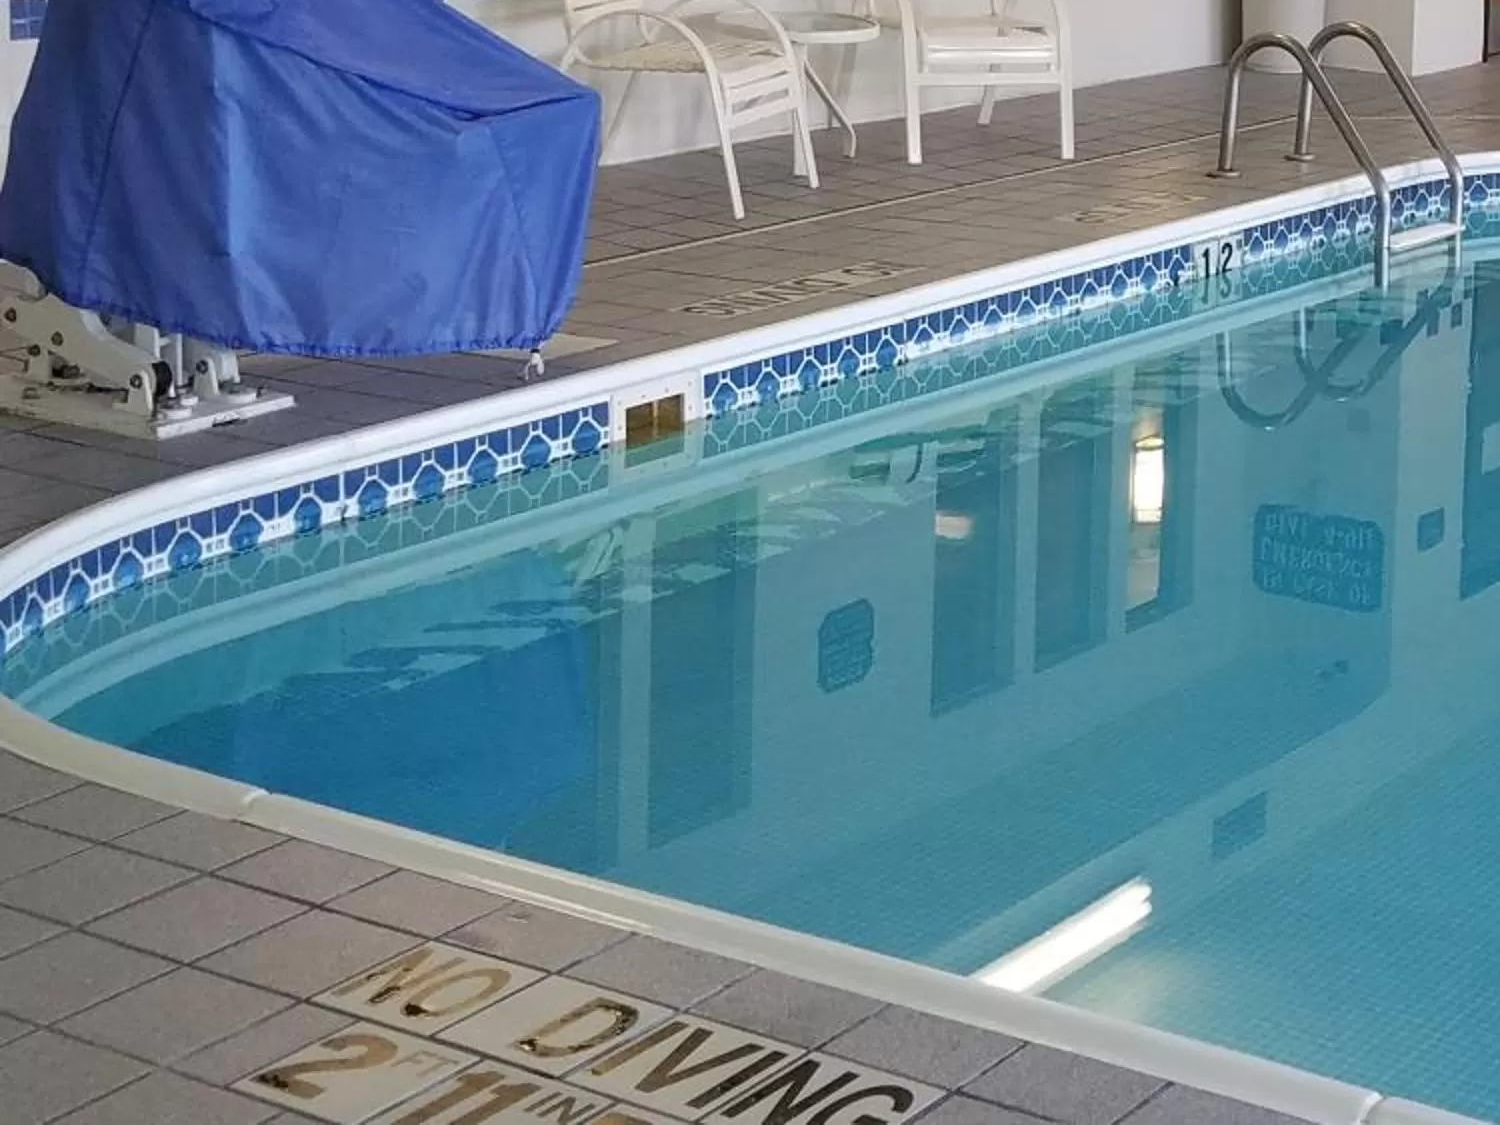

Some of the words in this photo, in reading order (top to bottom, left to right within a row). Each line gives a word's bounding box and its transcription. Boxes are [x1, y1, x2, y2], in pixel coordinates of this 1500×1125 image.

[250, 1034, 399, 1100] 2
[523, 1091, 596, 1125] IN
[331, 947, 512, 1017] NO
[512, 998, 913, 1125] DIVING
